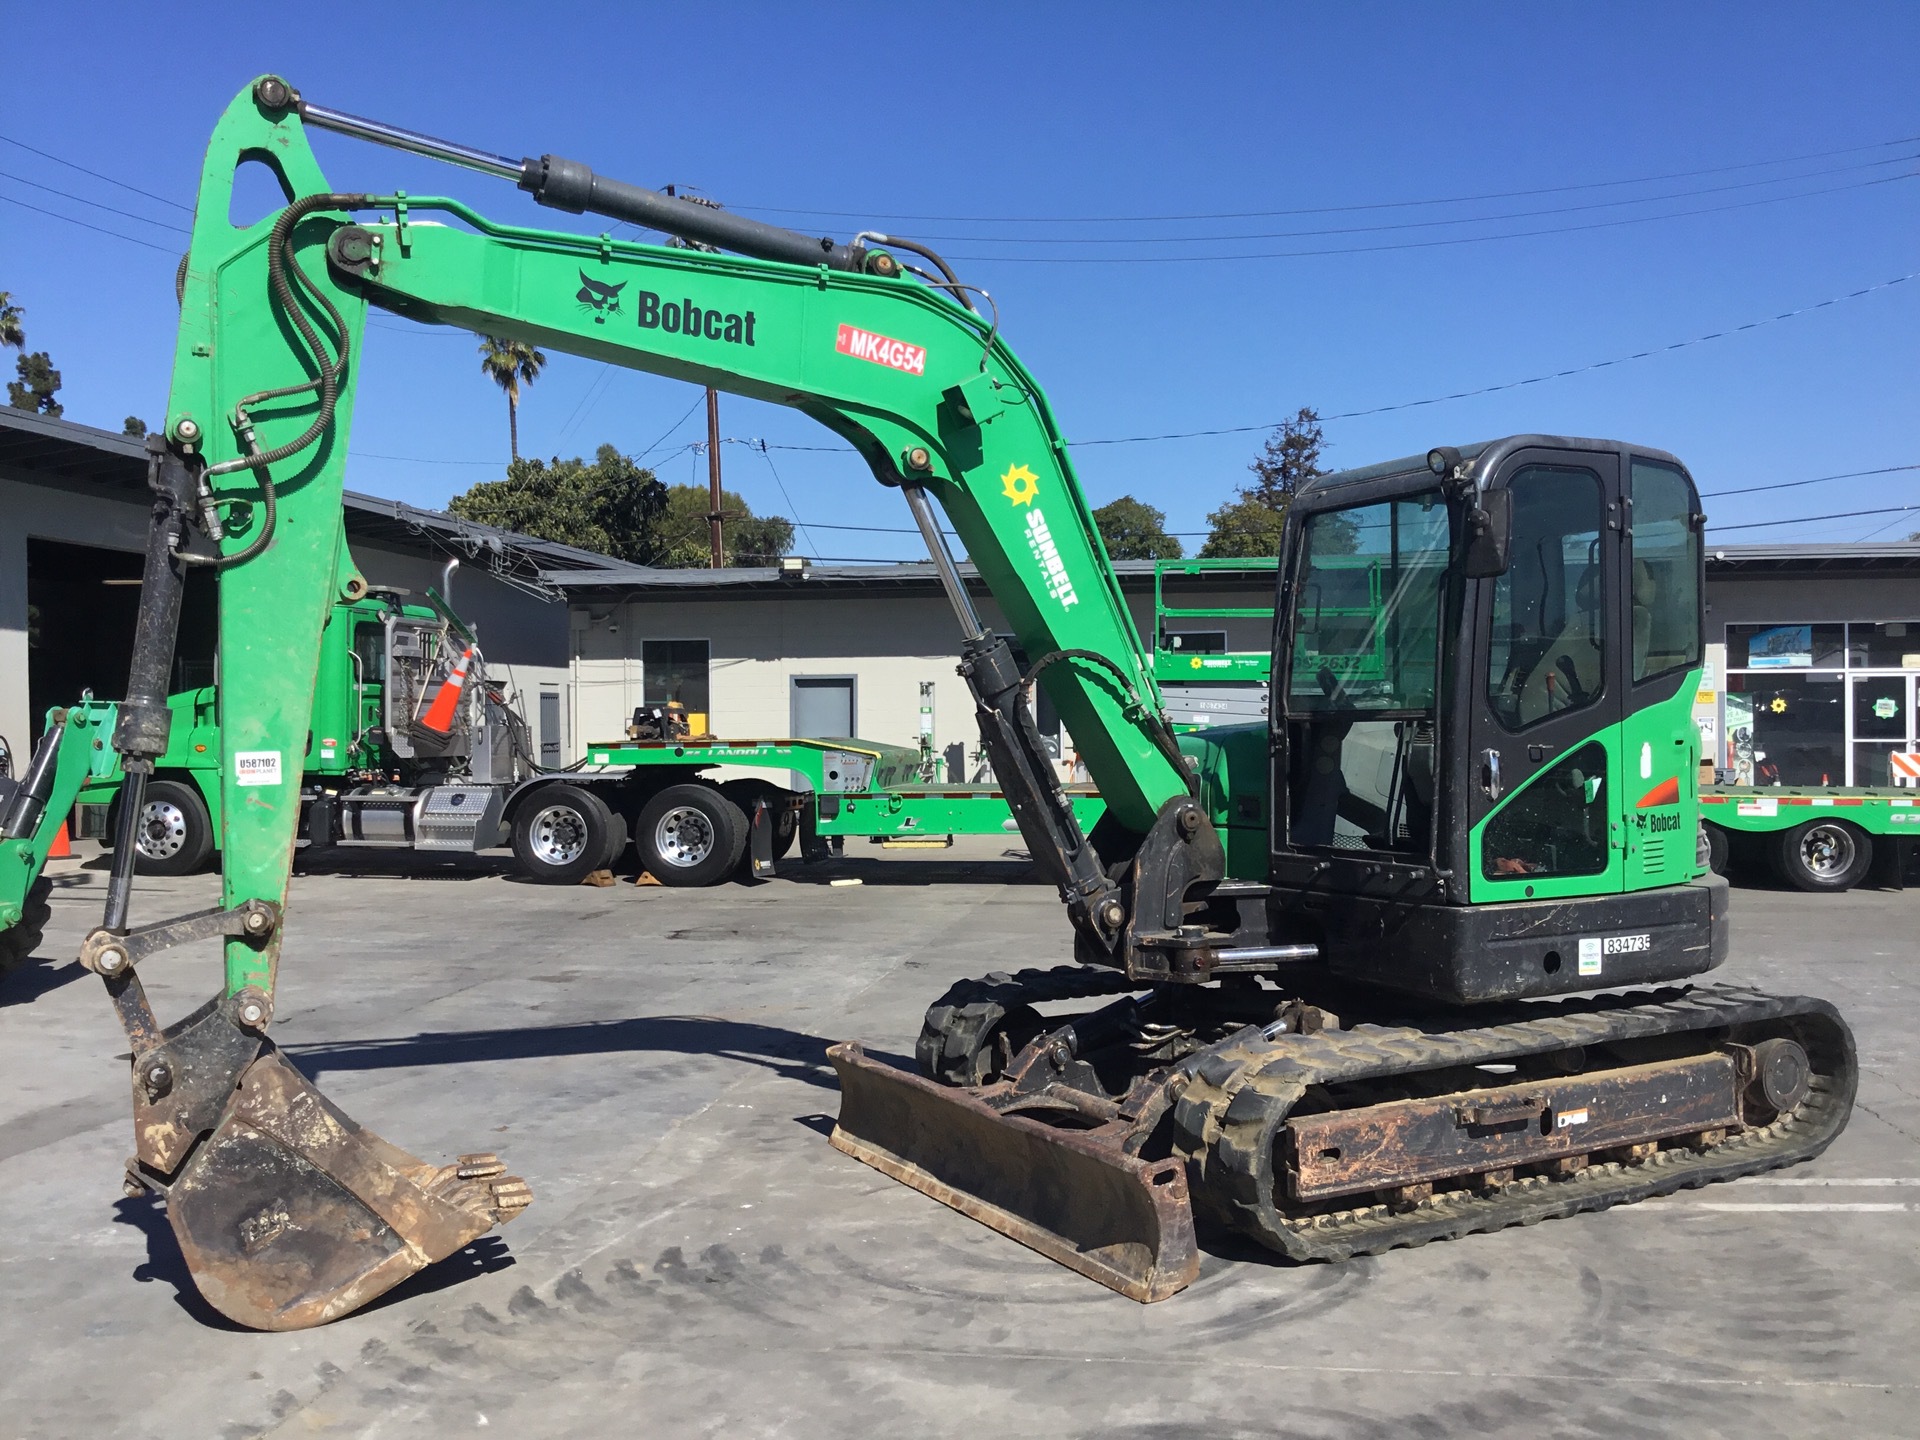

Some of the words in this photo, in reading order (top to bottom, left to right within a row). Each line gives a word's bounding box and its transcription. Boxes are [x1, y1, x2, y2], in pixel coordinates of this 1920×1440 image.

[638, 289, 756, 347] Bobcat
[850, 330, 925, 374] MK4G54
[1024, 528, 1058, 600] RENTALS
[1026, 508, 1079, 607] SUNBELT
[240, 758, 276, 769] U587102
[1650, 812, 1681, 833] Bobcat
[1607, 936, 1651, 954] 834735
